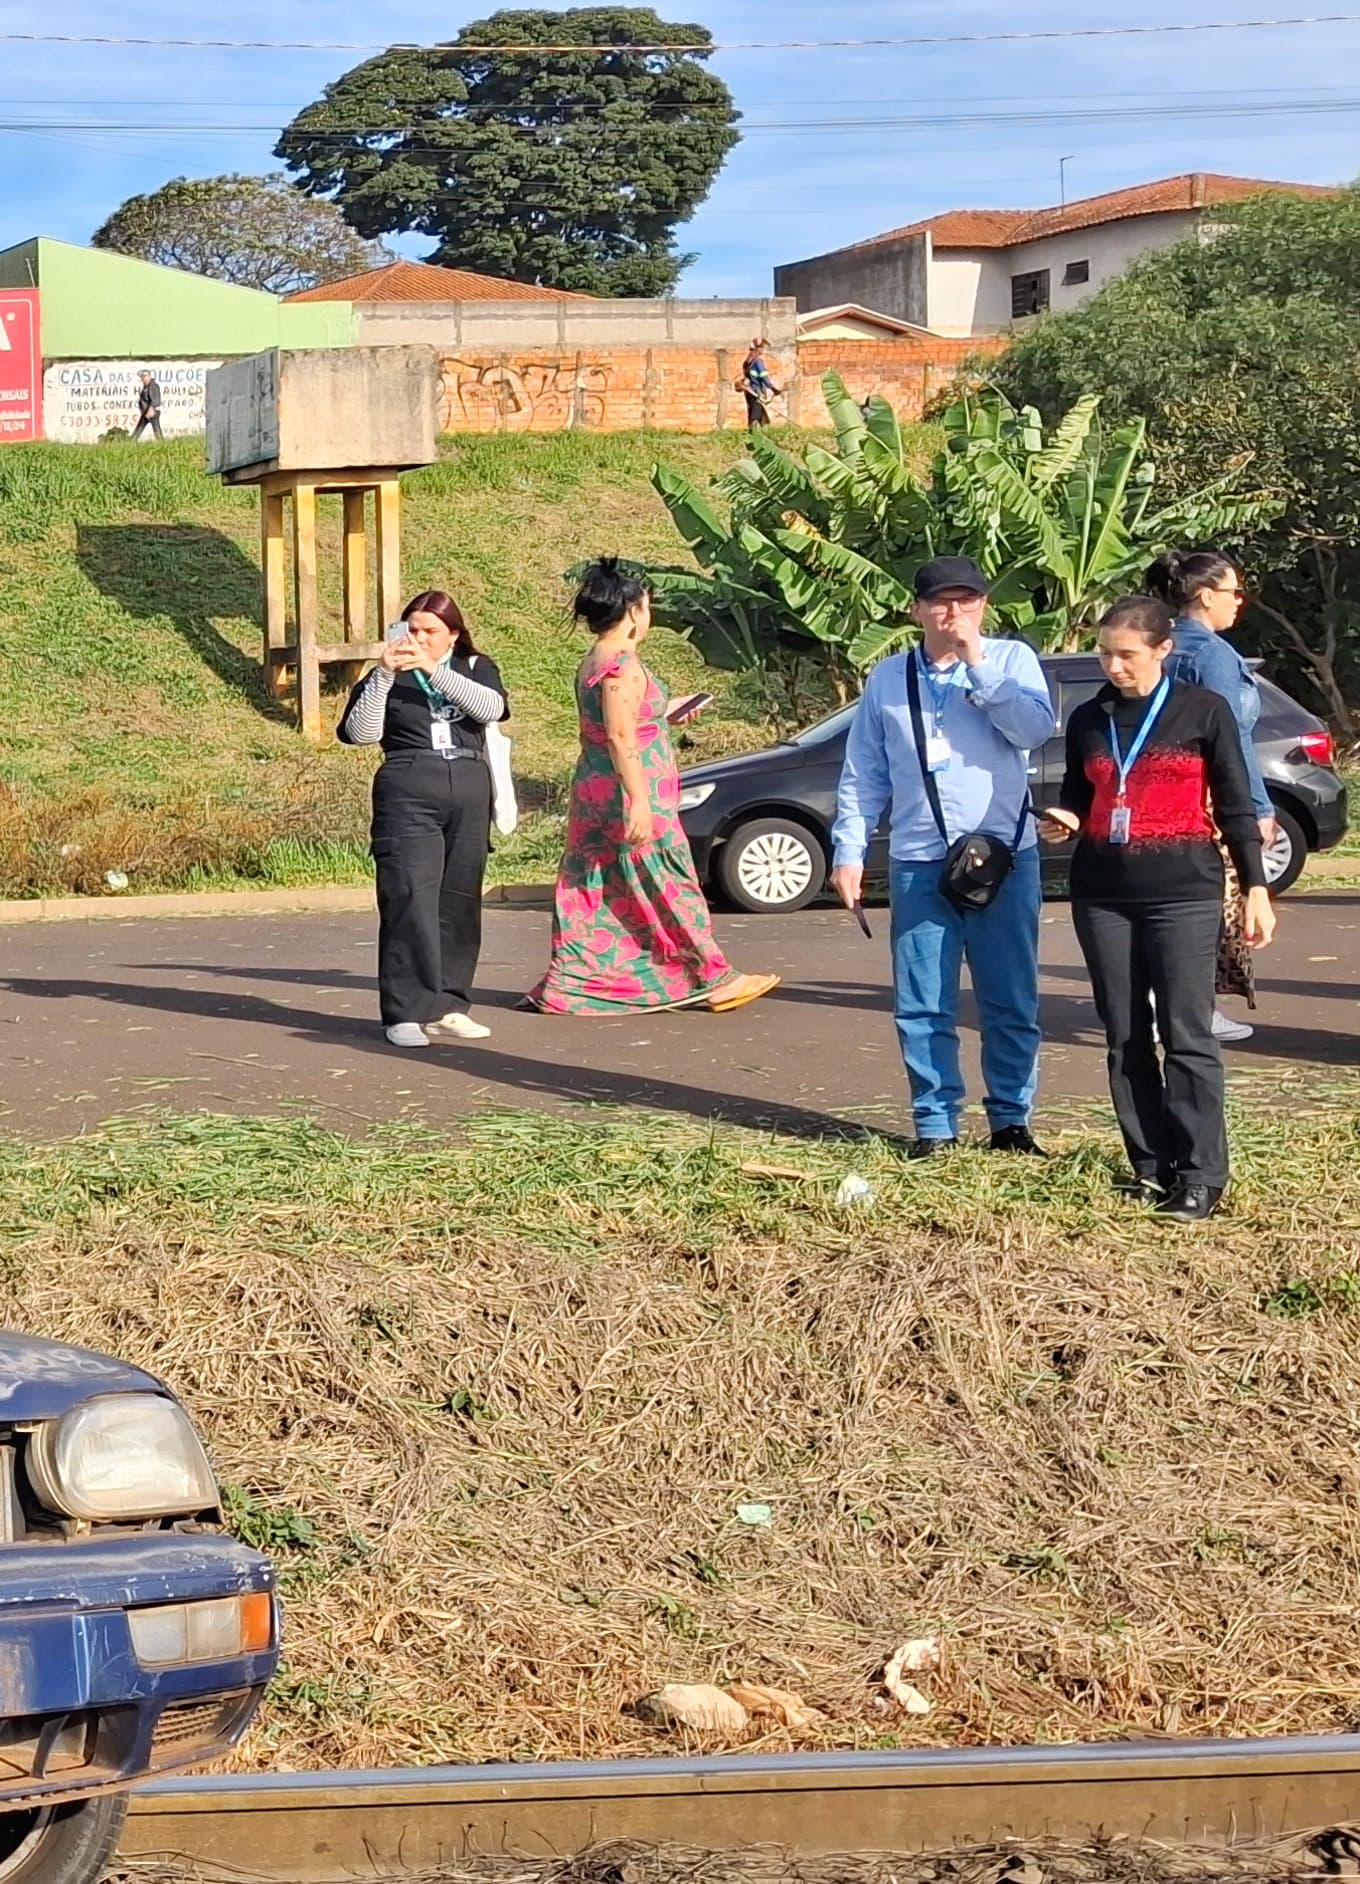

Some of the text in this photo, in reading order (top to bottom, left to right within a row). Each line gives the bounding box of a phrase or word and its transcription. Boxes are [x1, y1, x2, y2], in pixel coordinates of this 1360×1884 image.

[60, 368, 103, 385] CASA
[109, 372, 132, 383] DAS
[70, 386, 129, 397] MATERIAIS
